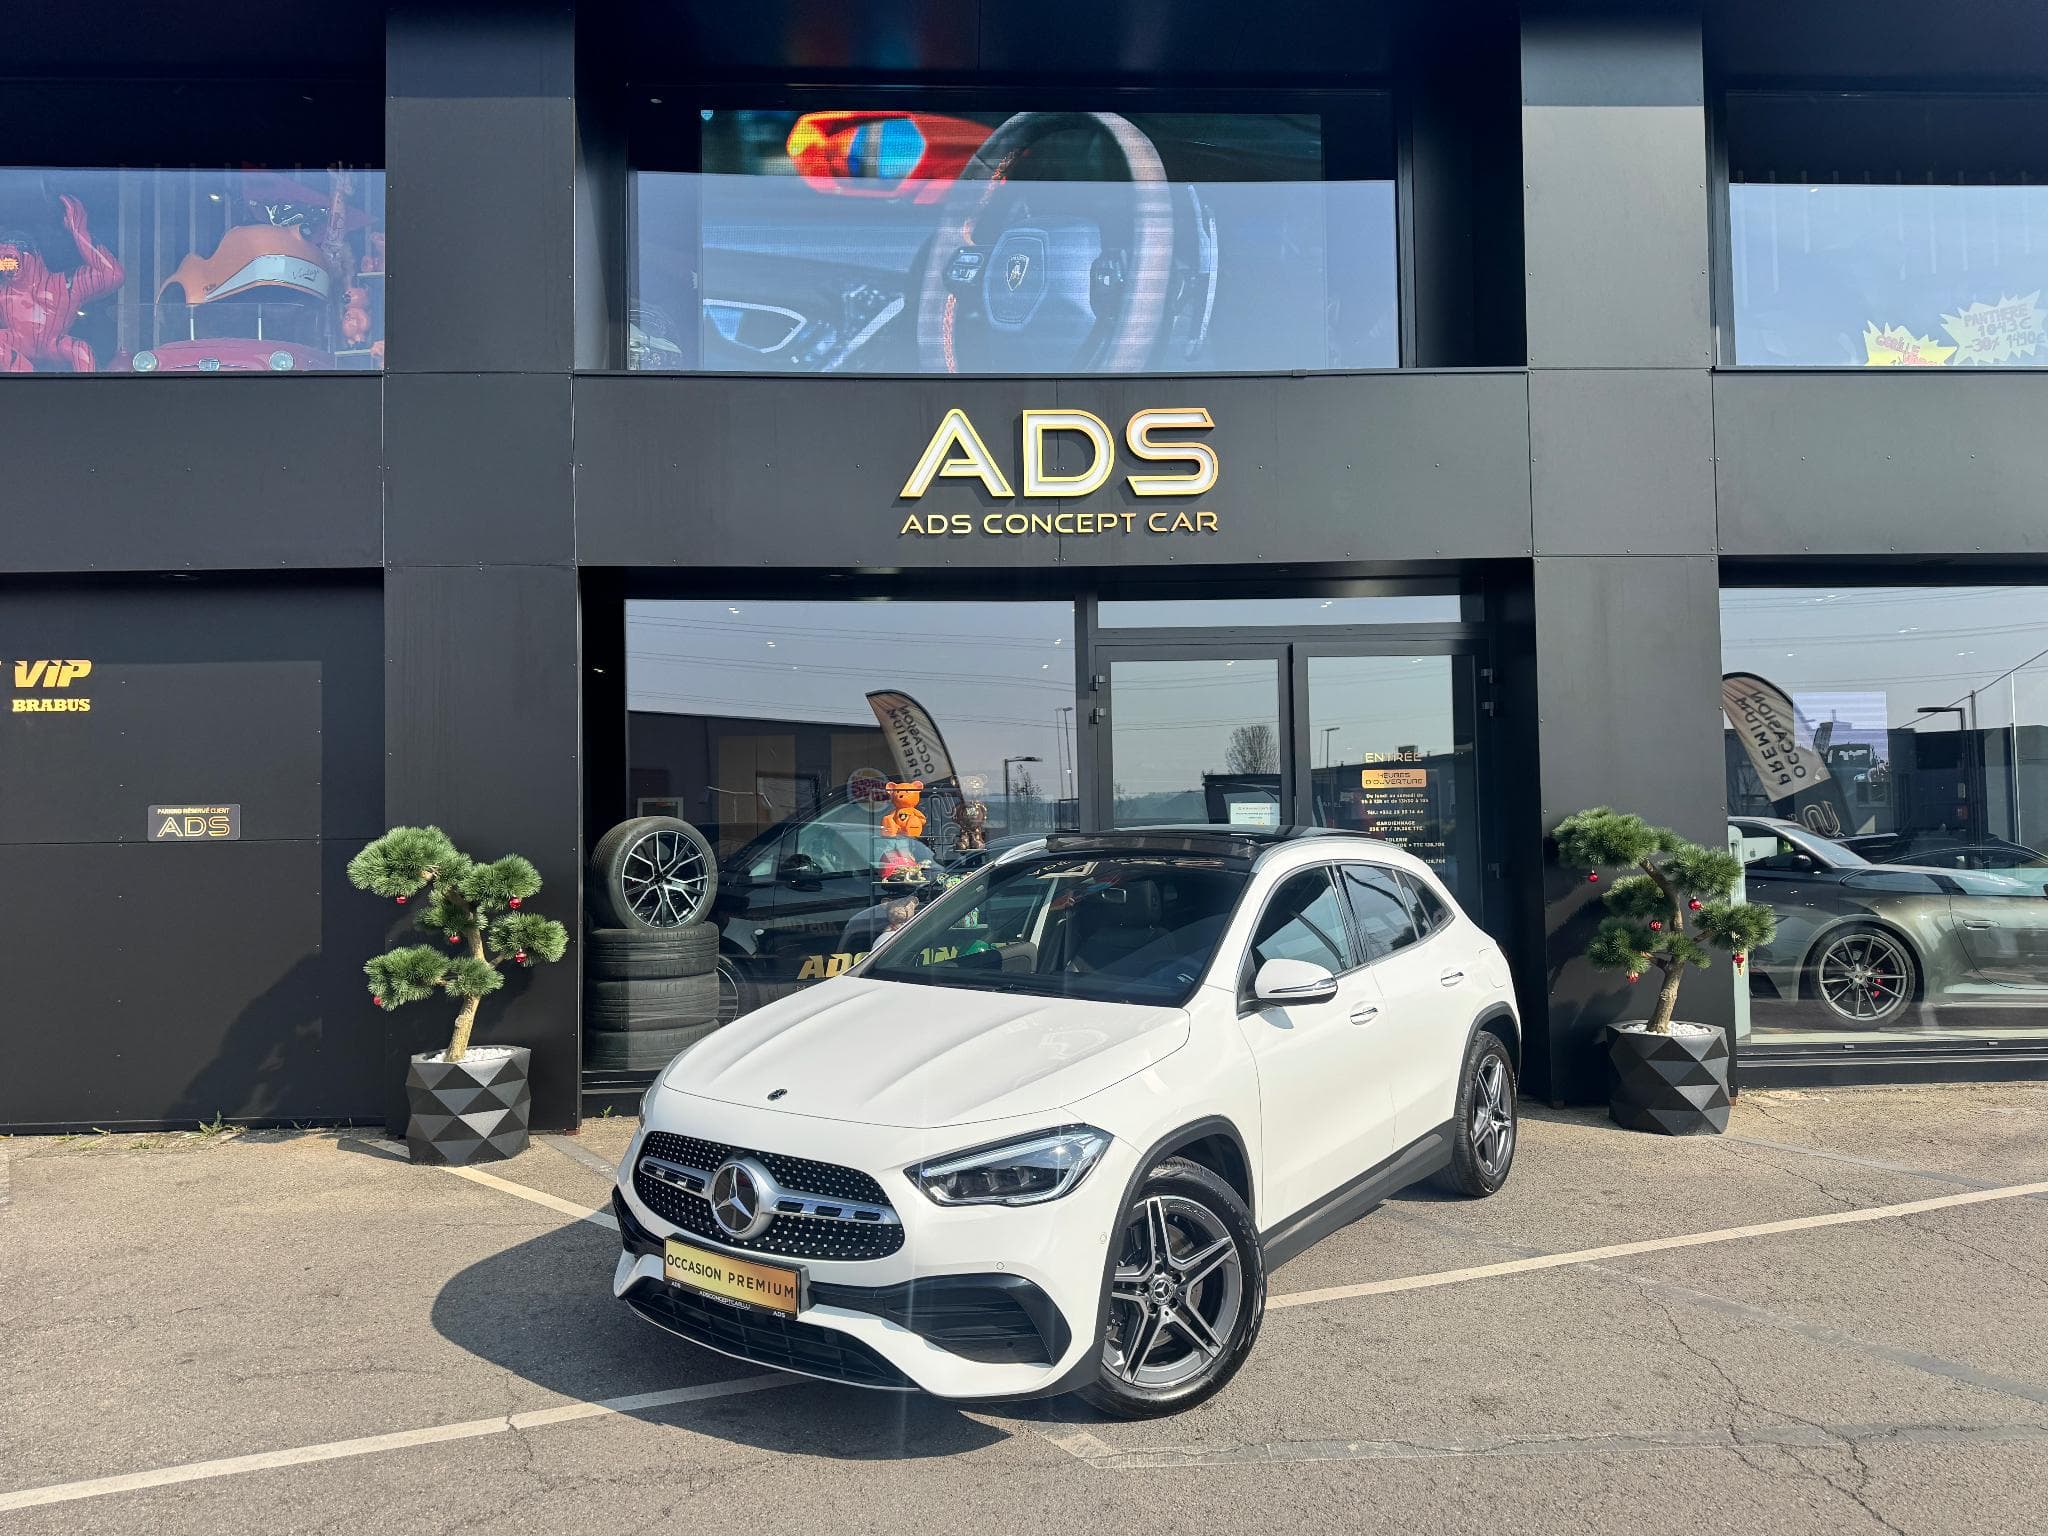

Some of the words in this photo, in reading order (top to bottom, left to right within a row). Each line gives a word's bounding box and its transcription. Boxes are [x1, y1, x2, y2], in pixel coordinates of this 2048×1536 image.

[899, 408, 1219, 498] ADS
[900, 513, 972, 535] ADS
[983, 512, 1136, 534] CONCEPT
[1149, 511, 1219, 533] CAR
[12, 698, 91, 713] BRABUS
[1365, 751, 1423, 763] ENTRÉE
[210, 806, 231, 815] CLIENT
[156, 815, 231, 838] ADS
[666, 1254, 722, 1281] OCCASION
[728, 1271, 794, 1299] PREMIUM
[772, 1310, 786, 1319] ADS
